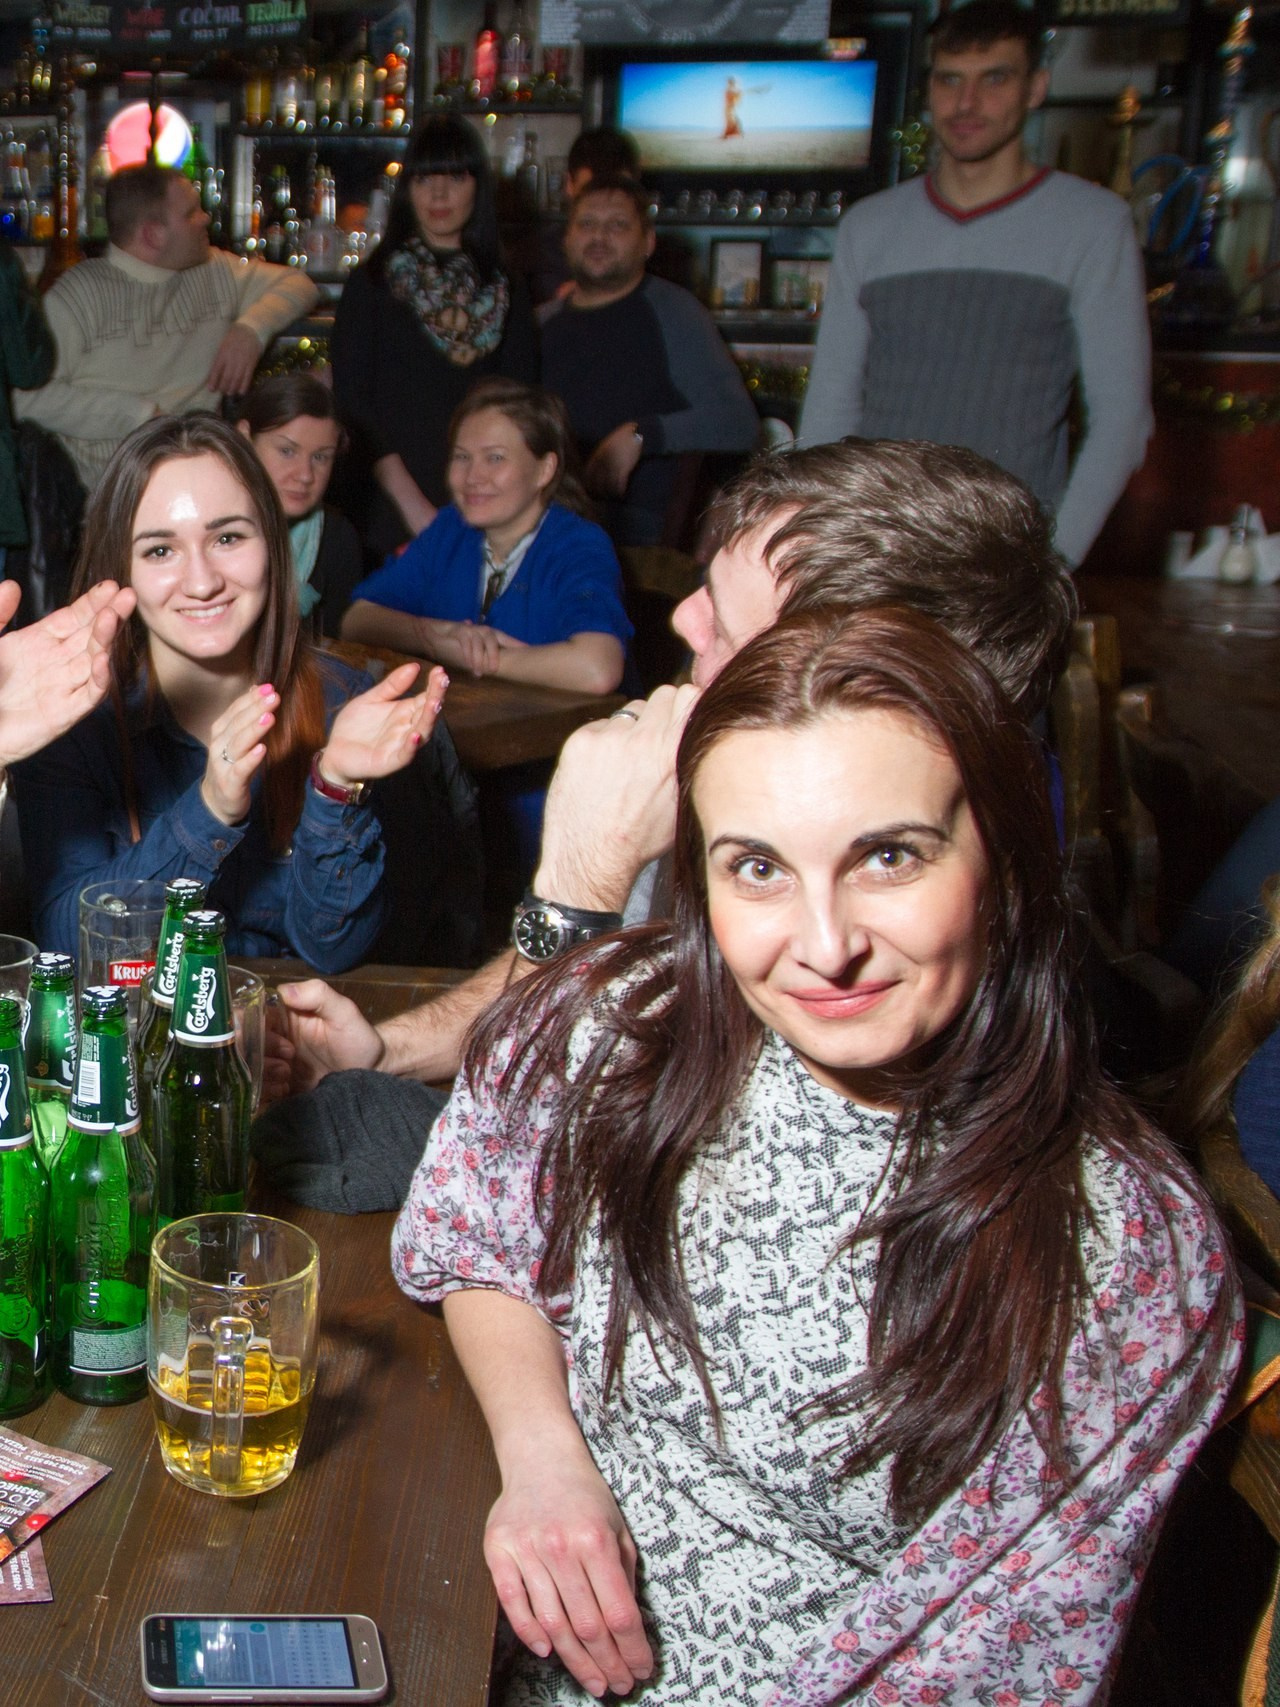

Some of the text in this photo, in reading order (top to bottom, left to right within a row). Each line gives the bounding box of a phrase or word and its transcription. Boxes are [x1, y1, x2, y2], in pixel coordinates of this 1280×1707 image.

[247, 1, 308, 22] TEQUILA
[157, 931, 184, 996] Carlsberg
[184, 966, 216, 1034] Carlsberg
[29, 1449, 90, 1470] AMBARCAFE.RU
[41, 1459, 59, 1468] 749
